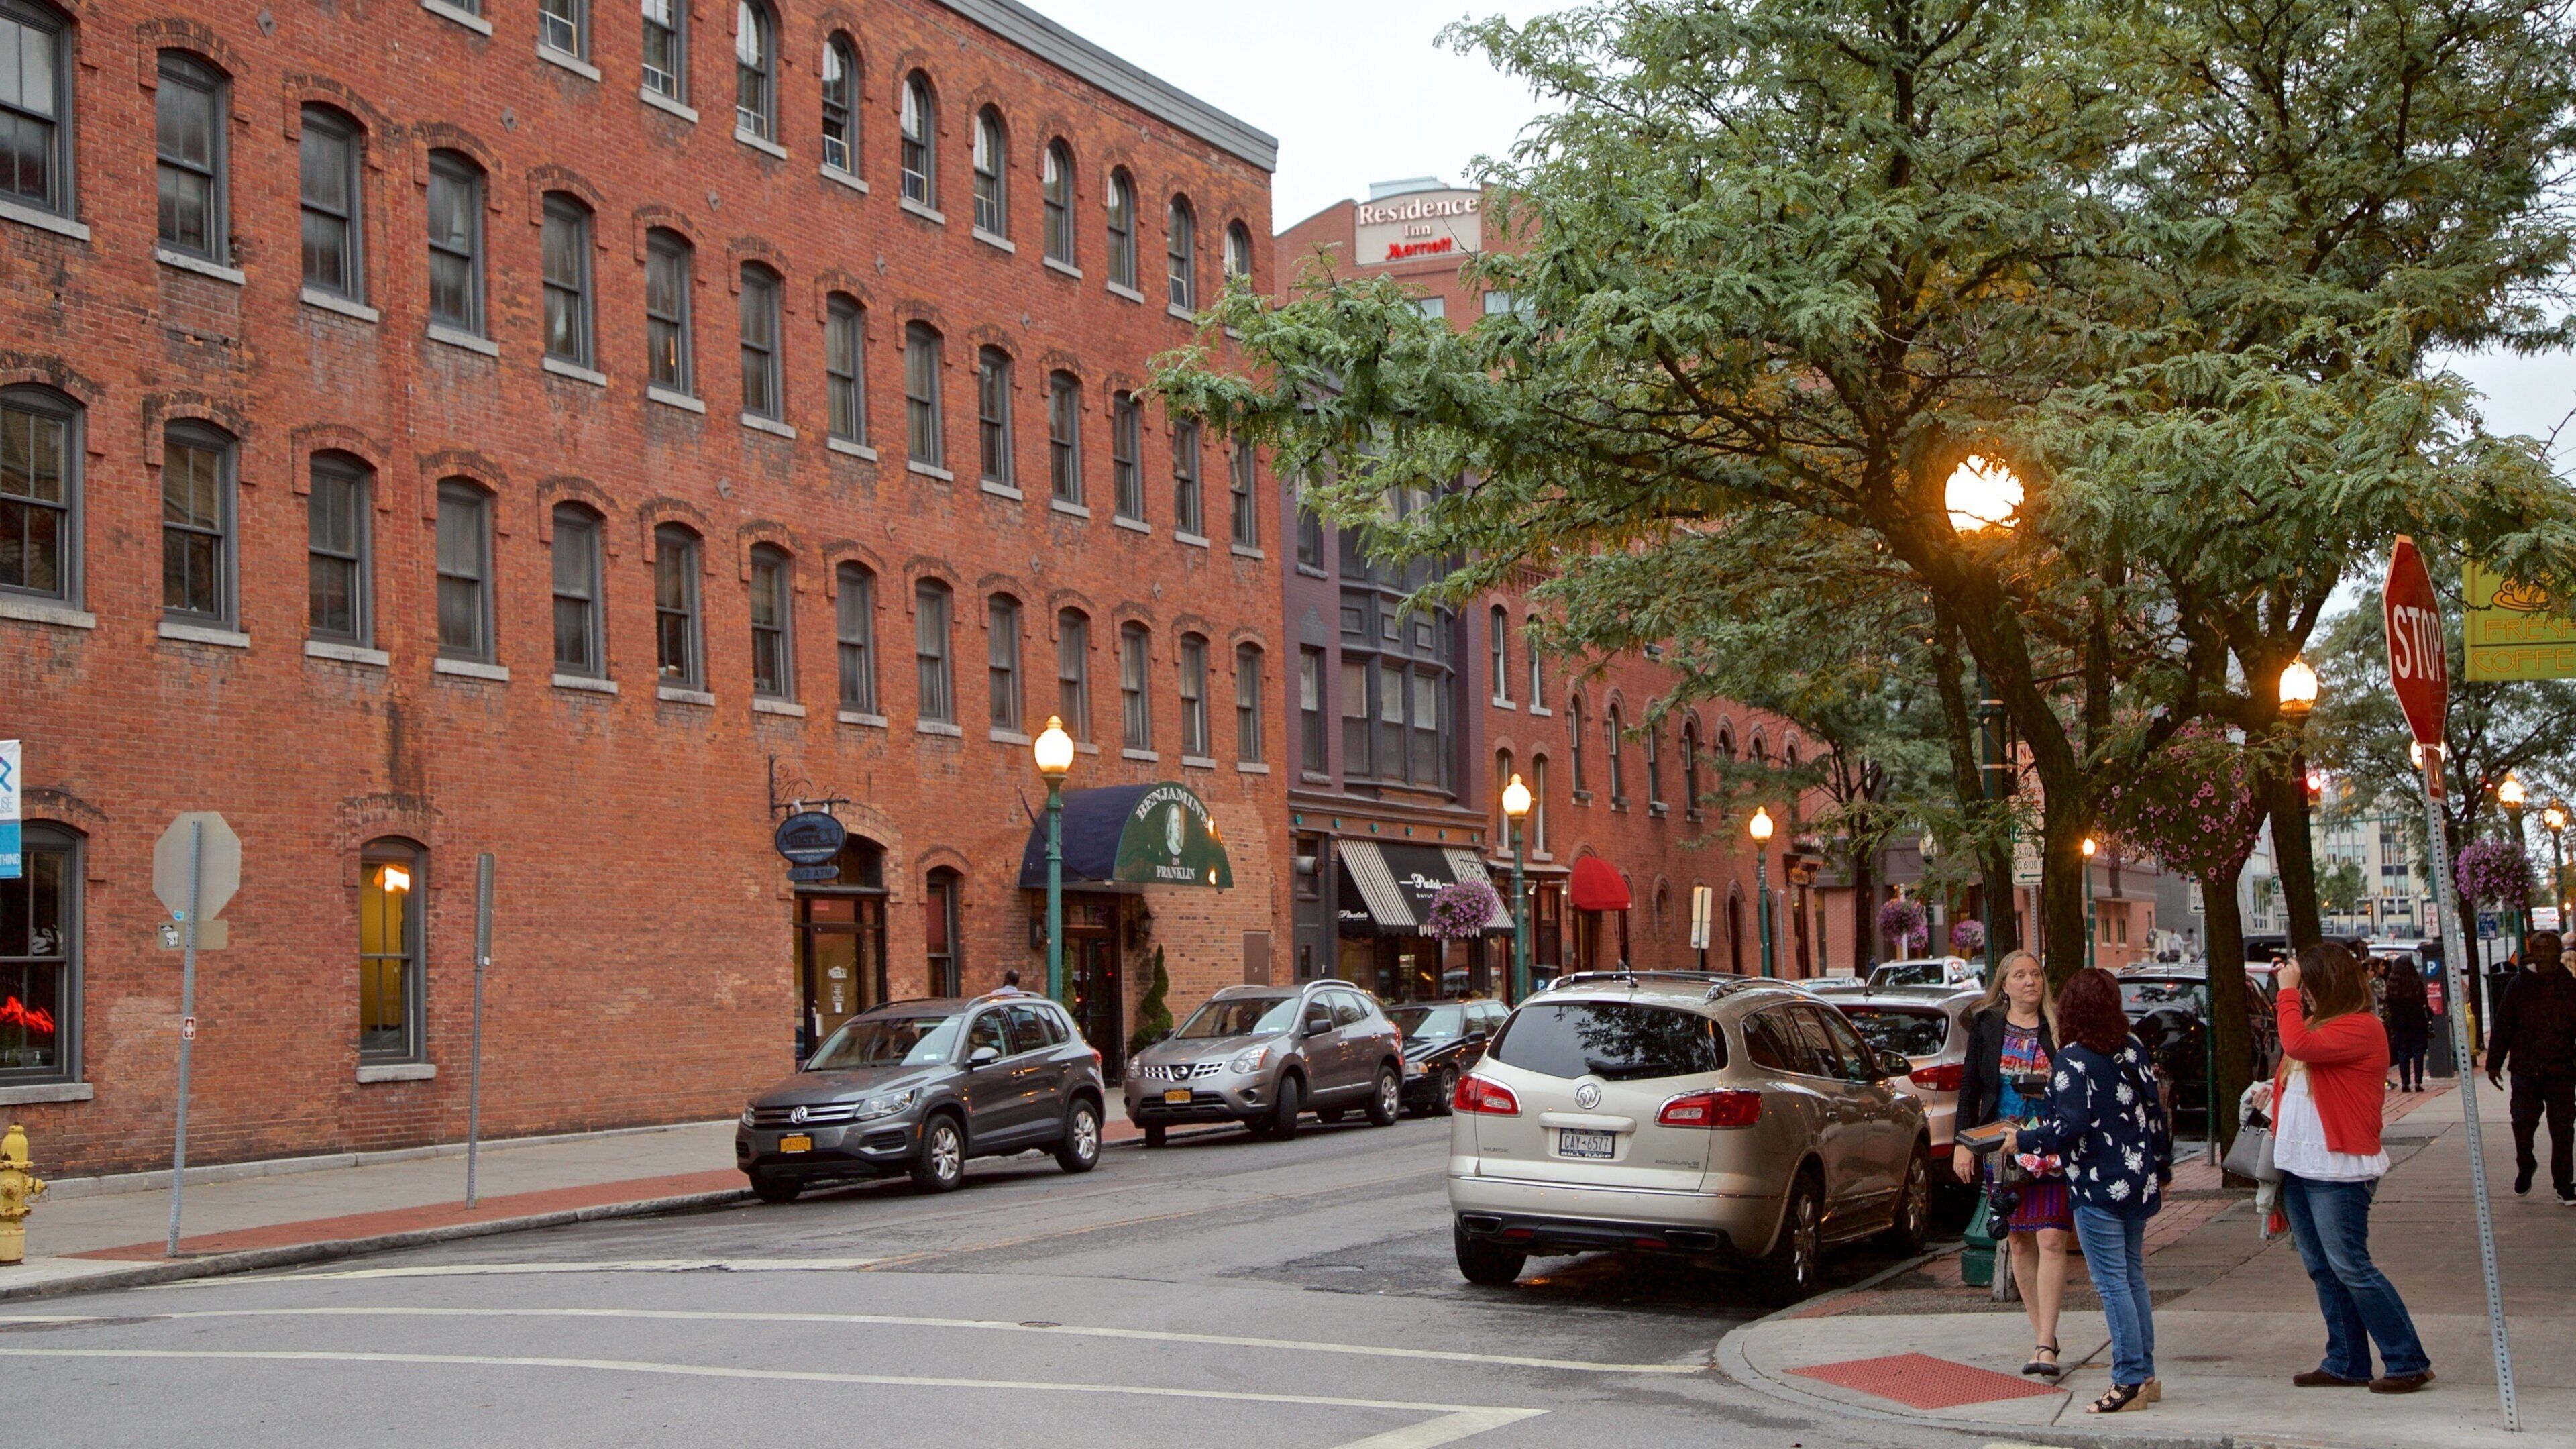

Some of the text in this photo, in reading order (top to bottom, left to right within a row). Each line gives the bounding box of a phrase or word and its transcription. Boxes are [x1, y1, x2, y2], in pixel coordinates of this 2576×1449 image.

[1359, 197, 1477, 225] Residence
[1404, 224, 1432, 237] Inn
[1385, 237, 1452, 260] Marriott
[2393, 604, 2441, 682] STOP
[1135, 787, 1208, 829] BENJAMIN'S
[778, 825, 841, 845] AmeriCU
[1172, 857, 1180, 866] ON
[1156, 865, 1195, 880] FRANKLIN
[2426, 961, 2436, 974] P
[1538, 979, 1545, 991] P
[1564, 1135, 1609, 1152] CAY 6577
